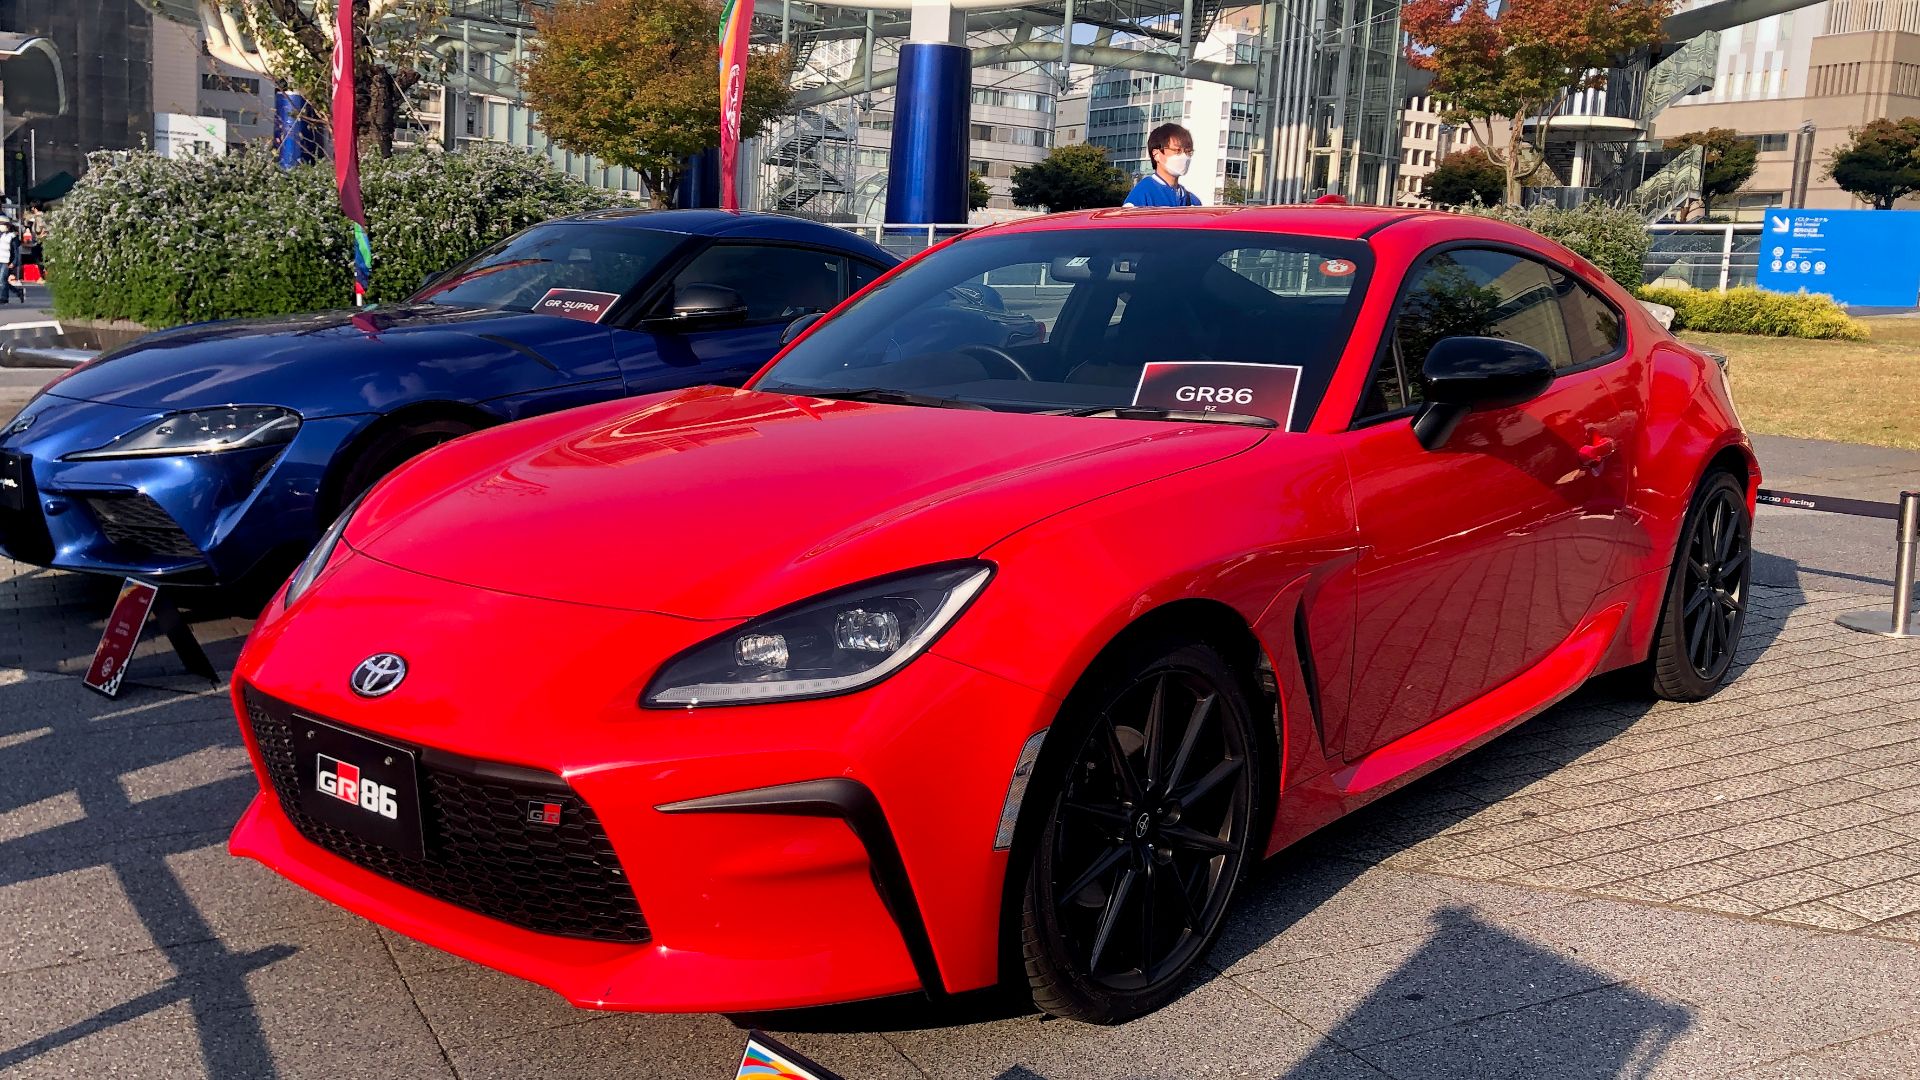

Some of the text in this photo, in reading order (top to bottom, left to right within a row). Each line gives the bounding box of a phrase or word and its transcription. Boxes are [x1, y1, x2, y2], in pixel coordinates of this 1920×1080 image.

[545, 299, 562, 307] GR
[562, 301, 599, 312] SUPRA
[1175, 385, 1254, 404] GR86
[1756, 495, 1815, 508] AZOO Racing
[319, 770, 398, 820] GR86
